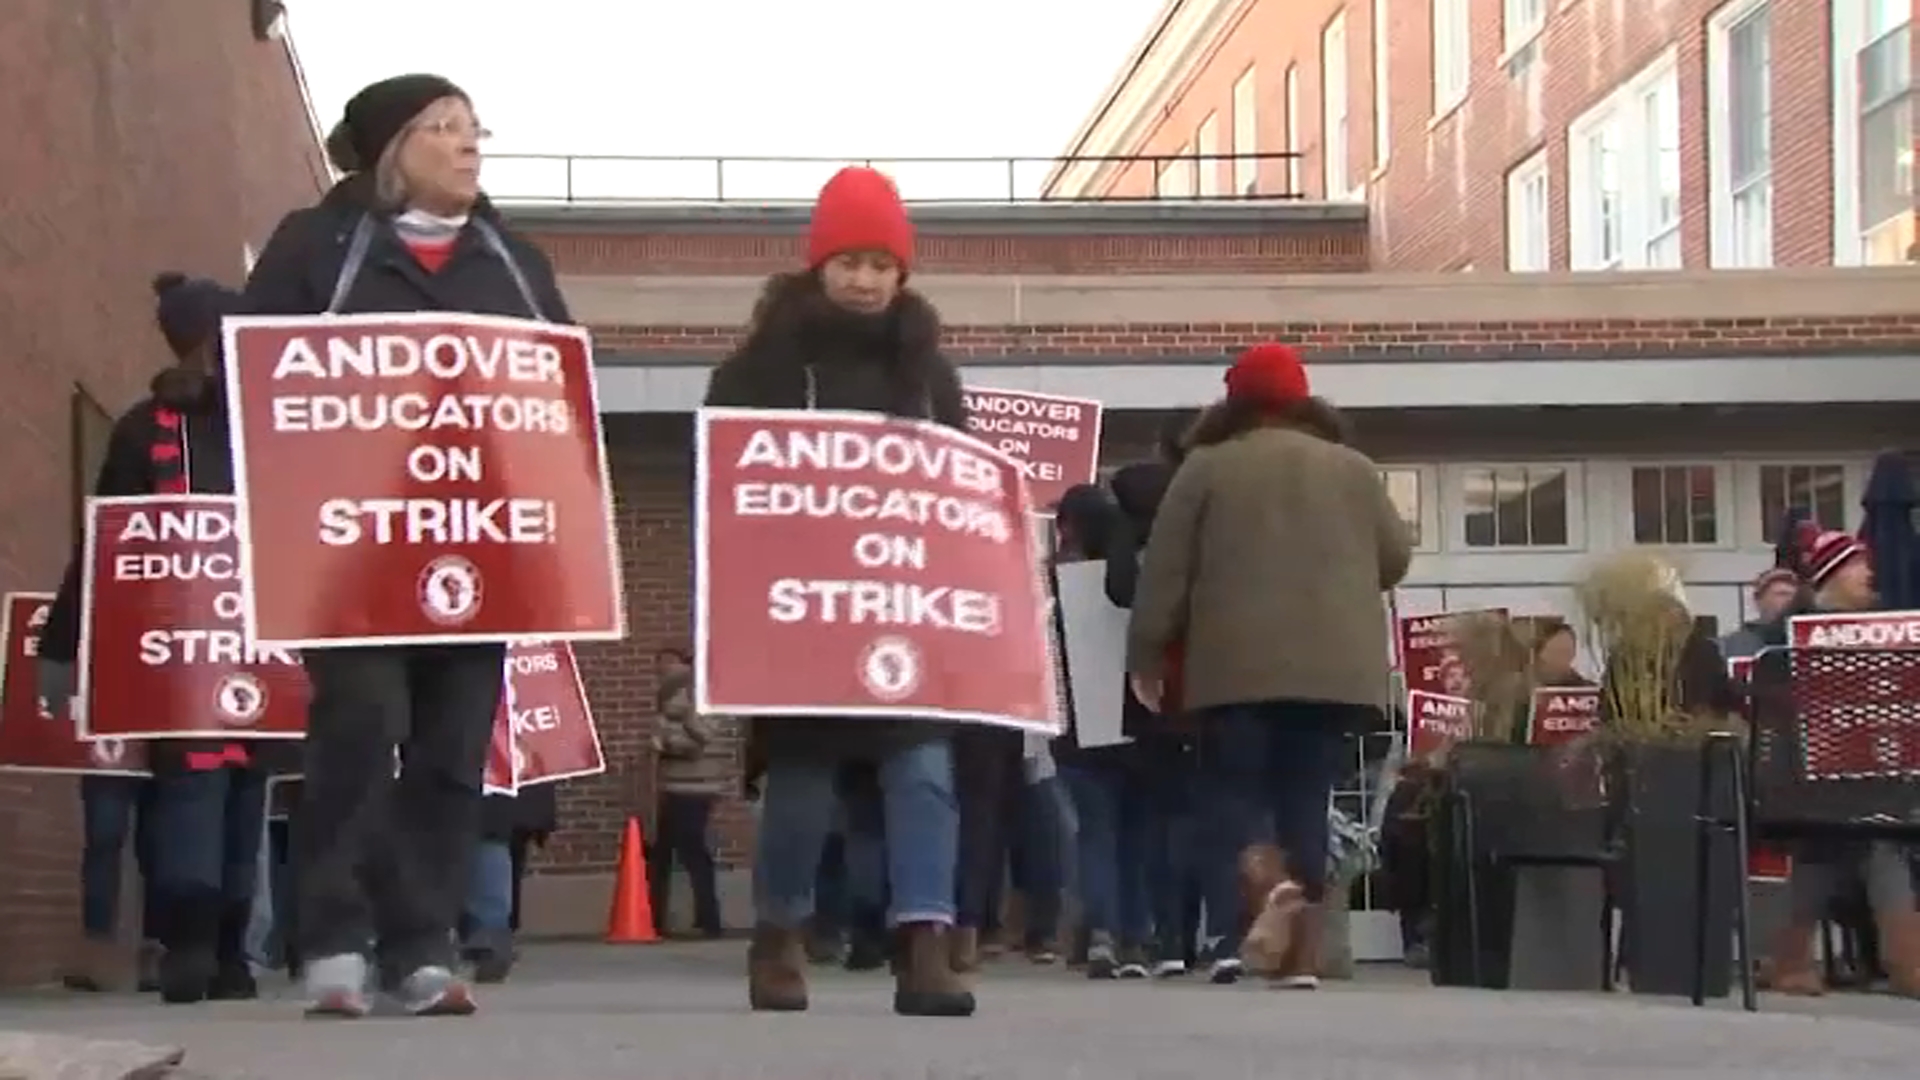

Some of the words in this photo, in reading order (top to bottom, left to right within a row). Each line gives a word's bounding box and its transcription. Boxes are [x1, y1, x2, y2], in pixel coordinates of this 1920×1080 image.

[272, 335, 564, 386] ANDOVER
[272, 393, 569, 434] EDUCATORS
[408, 445, 481, 482] ON
[737, 430, 1004, 497] ANDOVER
[999, 439, 1031, 455] ON
[119, 511, 239, 542] AND
[319, 499, 556, 545] STRIKE!
[734, 483, 1013, 543] EDUCATORS
[115, 553, 241, 580] EDUC
[854, 533, 926, 570] ON
